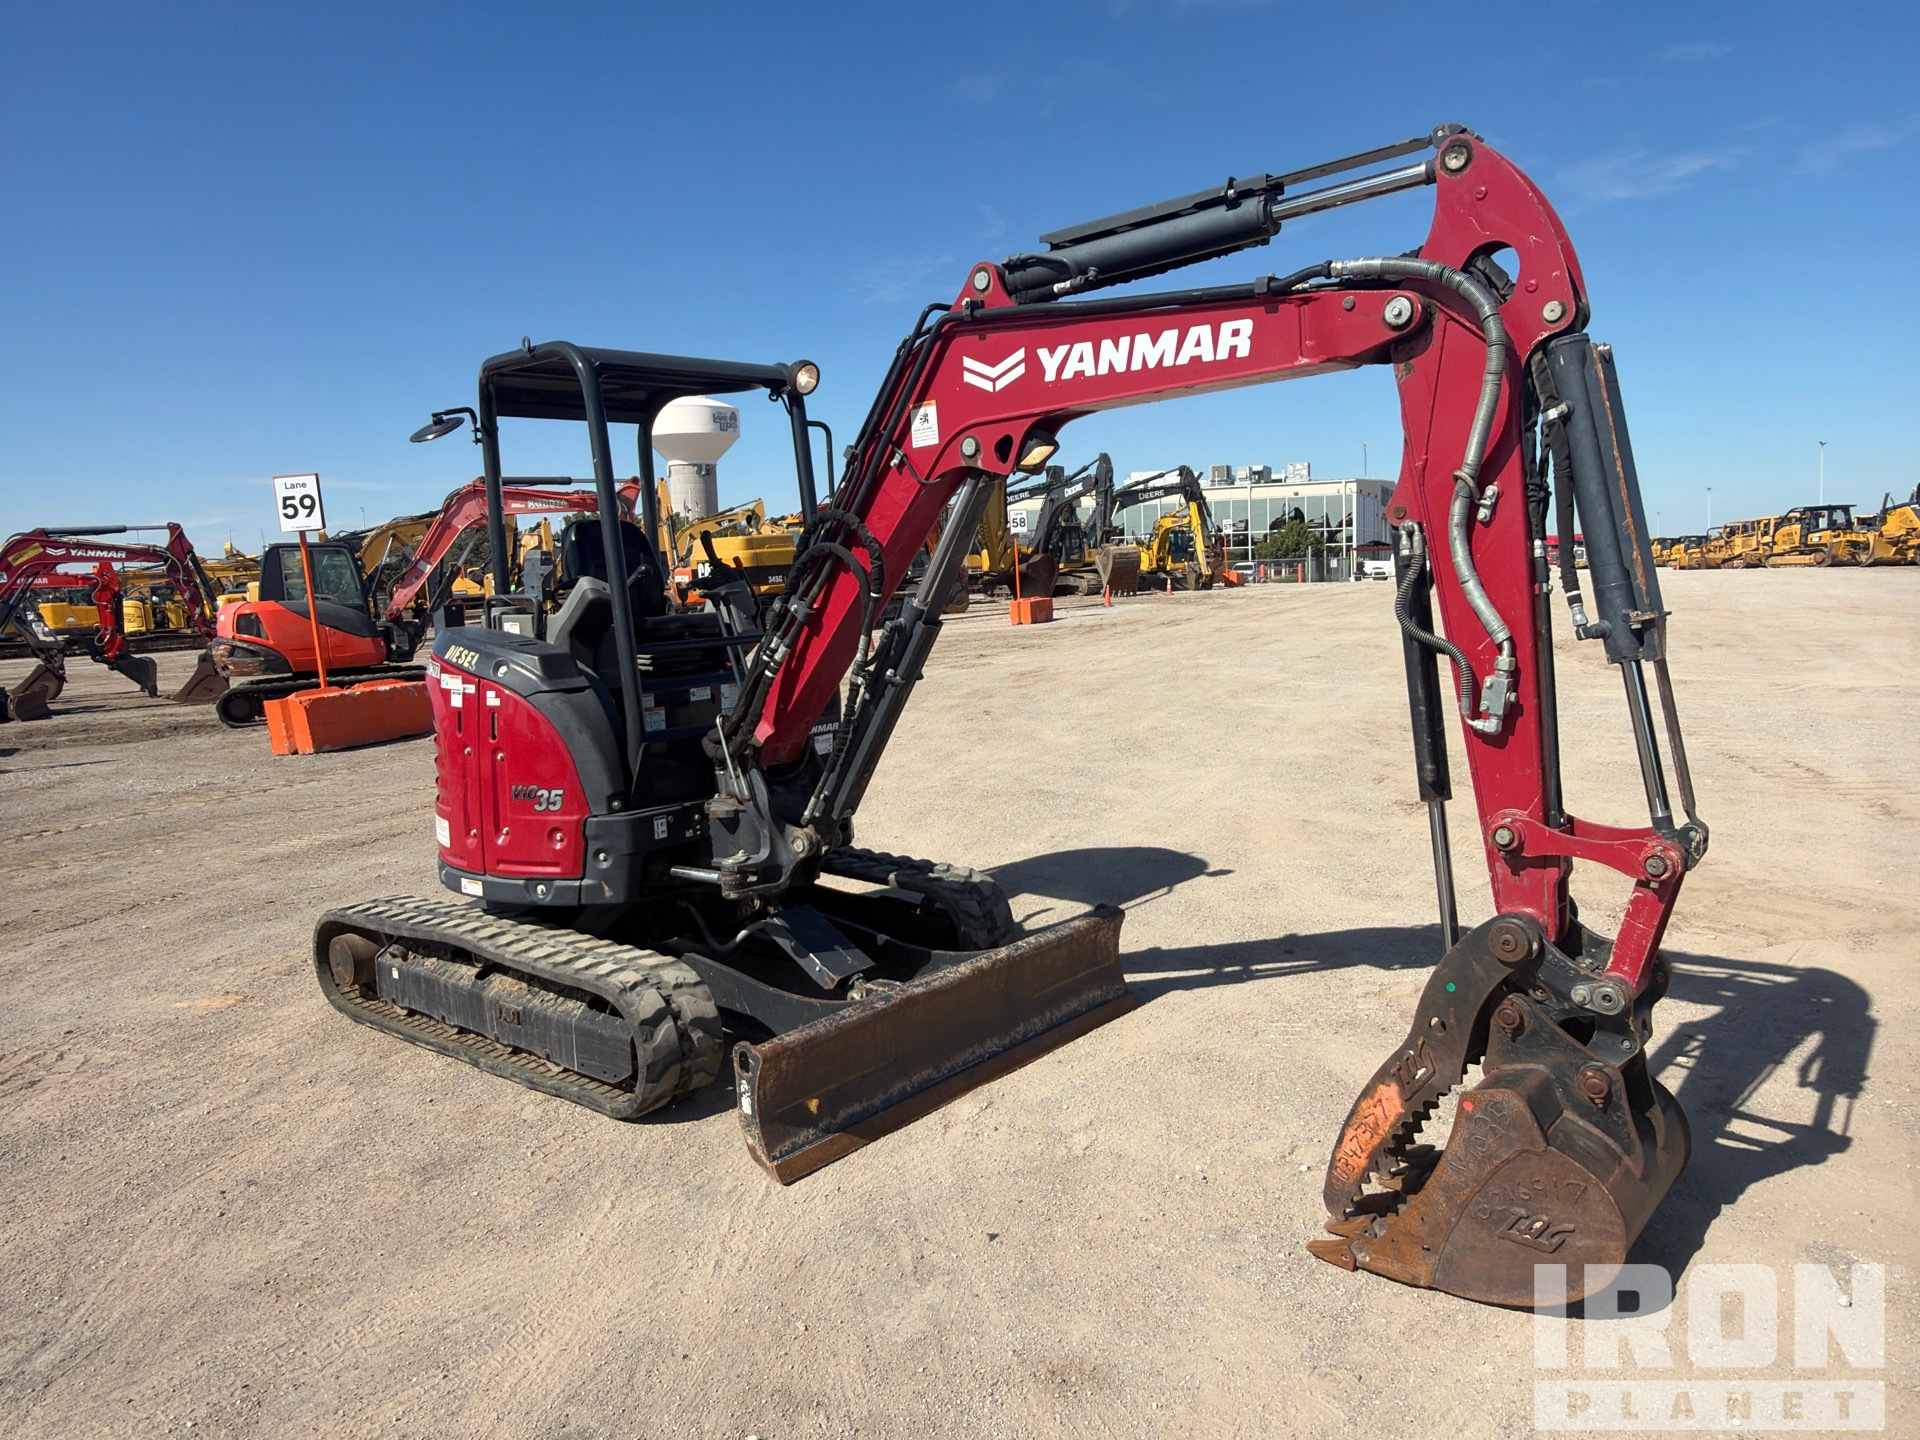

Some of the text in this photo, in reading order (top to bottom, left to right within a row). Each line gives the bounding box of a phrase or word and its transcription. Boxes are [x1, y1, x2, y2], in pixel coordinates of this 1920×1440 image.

[1036, 318, 1254, 382] YANMAR
[284, 481, 307, 490] Lane
[1064, 482, 1084, 498] DEERE
[1138, 489, 1165, 501] DEERE
[282, 494, 316, 520] 59
[1012, 517, 1026, 528] 58
[1223, 523, 1232, 531] 57
[69, 548, 126, 559] YANMAR
[444, 645, 480, 671] DIESEL
[809, 721, 840, 734] NMAR
